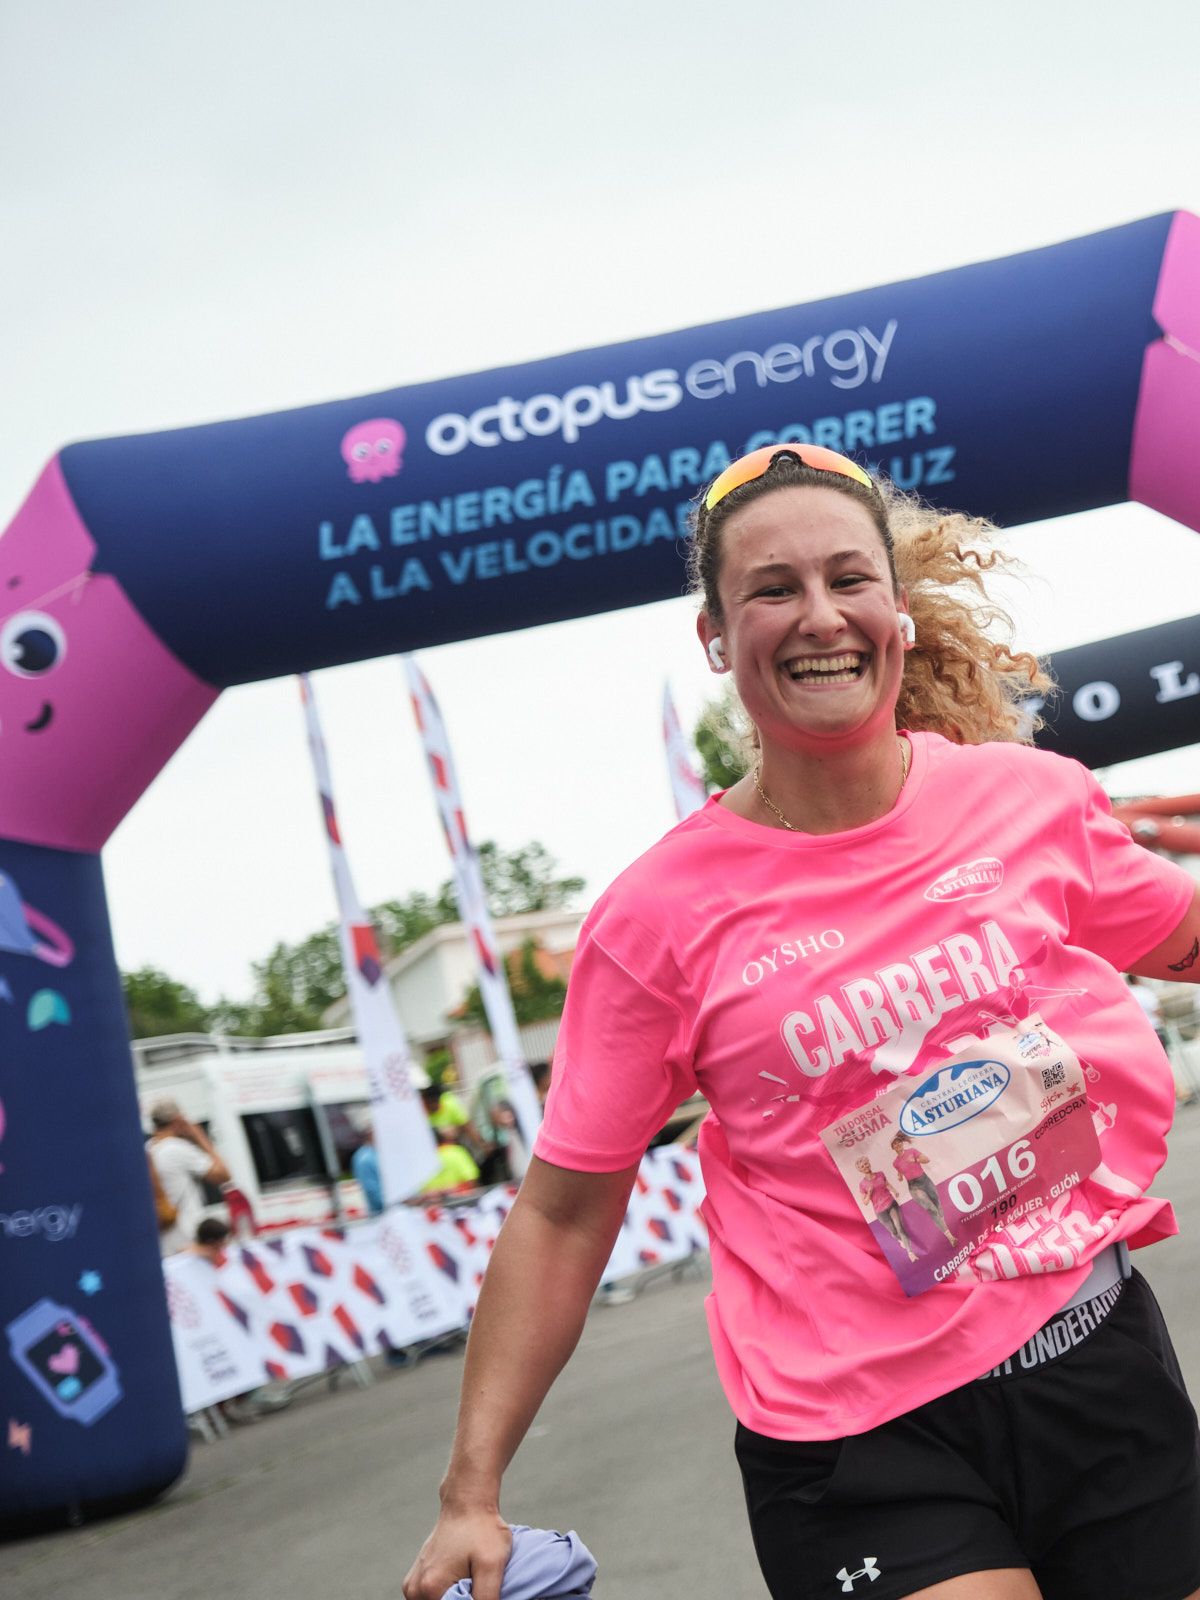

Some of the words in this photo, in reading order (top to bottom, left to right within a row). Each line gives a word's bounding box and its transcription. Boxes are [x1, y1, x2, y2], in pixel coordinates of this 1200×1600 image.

[425, 368, 684, 456] octopus
[685, 319, 898, 399] energy
[319, 513, 381, 561] LA
[389, 464, 596, 546] ENERGÍA
[605, 440, 736, 502] PARA
[325, 570, 362, 609] A
[369, 557, 432, 600] LA
[867, 446, 957, 490] UZ
[931, 869, 1001, 900] ASTURIANA
[741, 929, 846, 987] OYSHO
[780, 920, 1026, 1079] CARRERA
[833, 1123, 847, 1136] TU
[847, 1104, 884, 1130] DORSAL
[840, 1113, 892, 1148] SUMA
[910, 1072, 1005, 1132] ASTURIANA
[947, 1139, 1037, 1213] 016
[991, 1194, 1018, 1219] 190
[933, 1241, 976, 1282] CARRERA
[977, 1229, 989, 1245] DE
[1006, 1196, 1044, 1224] MUJER
[1050, 1171, 1081, 1199] GIJÓN
[1018, 1303, 1097, 1370] UNDER
